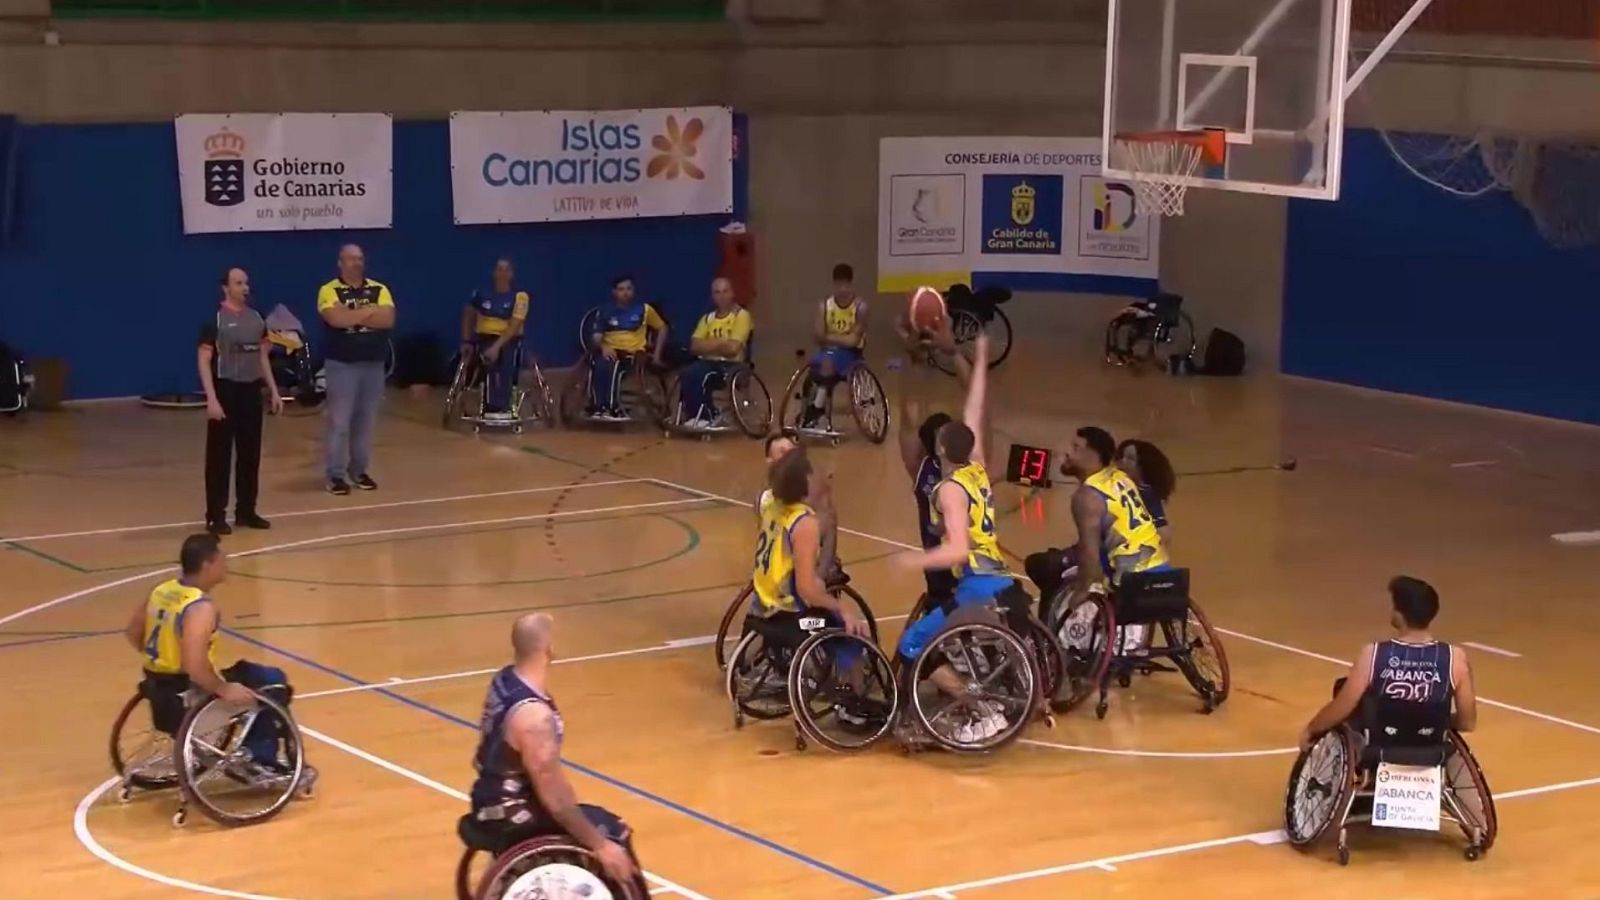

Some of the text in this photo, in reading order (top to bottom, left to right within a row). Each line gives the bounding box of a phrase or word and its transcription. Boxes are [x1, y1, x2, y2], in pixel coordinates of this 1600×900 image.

[562, 118, 641, 151] Islas
[253, 158, 345, 176] Gobierno
[1023, 154, 1040, 165] DE
[1042, 153, 1102, 166] DEPORTES
[482, 152, 641, 187] Canarias
[254, 179, 366, 198] de Canarias
[256, 204, 343, 221] un solo pueblo
[553, 195, 640, 213] LATITUD DE VIDA
[992, 227, 1049, 239] Cabildo de
[988, 239, 1056, 250] Gran Canaria
[1020, 450, 1047, 480] 13
[1121, 489, 1151, 530] 25
[755, 530, 775, 575] 24
[145, 624, 161, 660] 4
